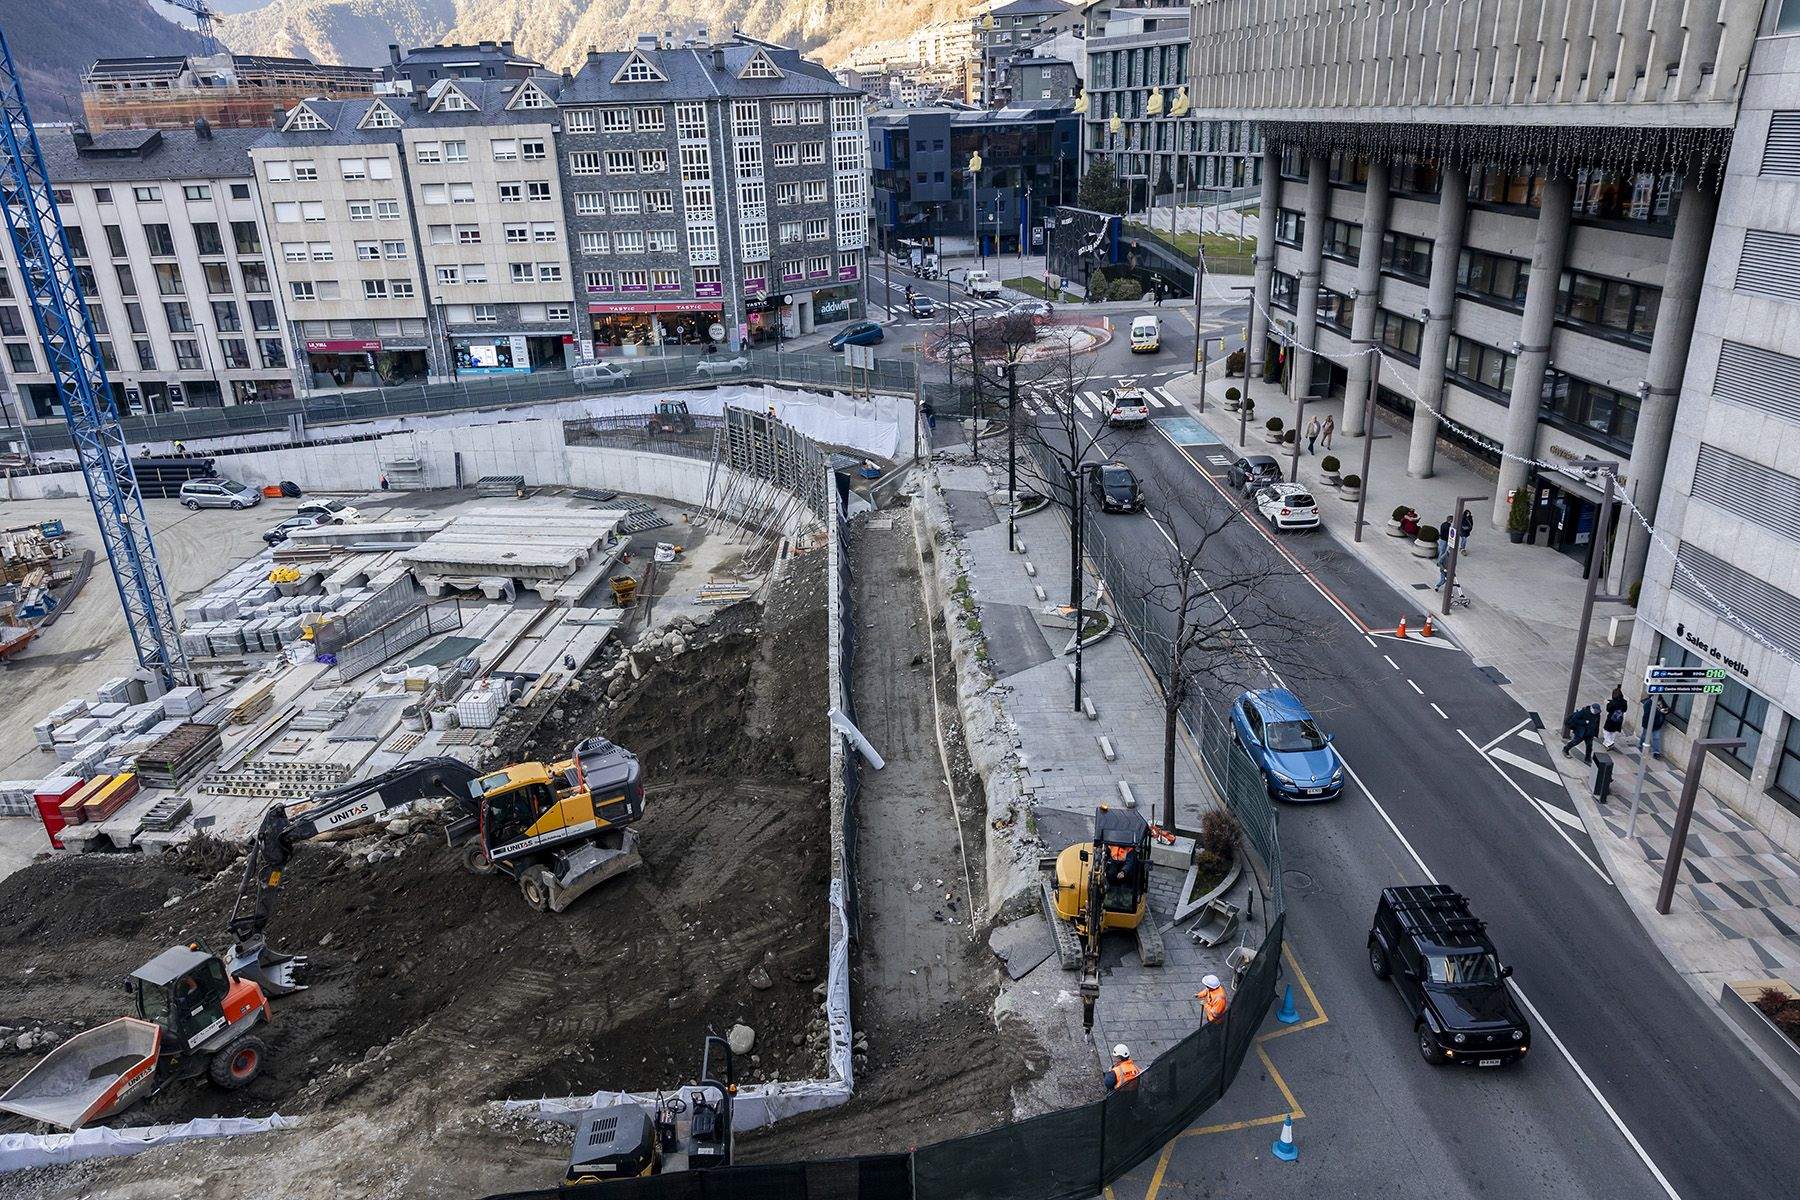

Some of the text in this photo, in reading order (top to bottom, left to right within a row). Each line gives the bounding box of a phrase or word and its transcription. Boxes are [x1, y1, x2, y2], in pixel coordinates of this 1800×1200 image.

[746, 300, 768, 308] TASTIC
[1686, 632, 1749, 677] Sales de vetlla
[329, 803, 369, 824] UNITAS
[506, 839, 534, 852] UNITAS
[128, 1067, 153, 1087] UNITAS
